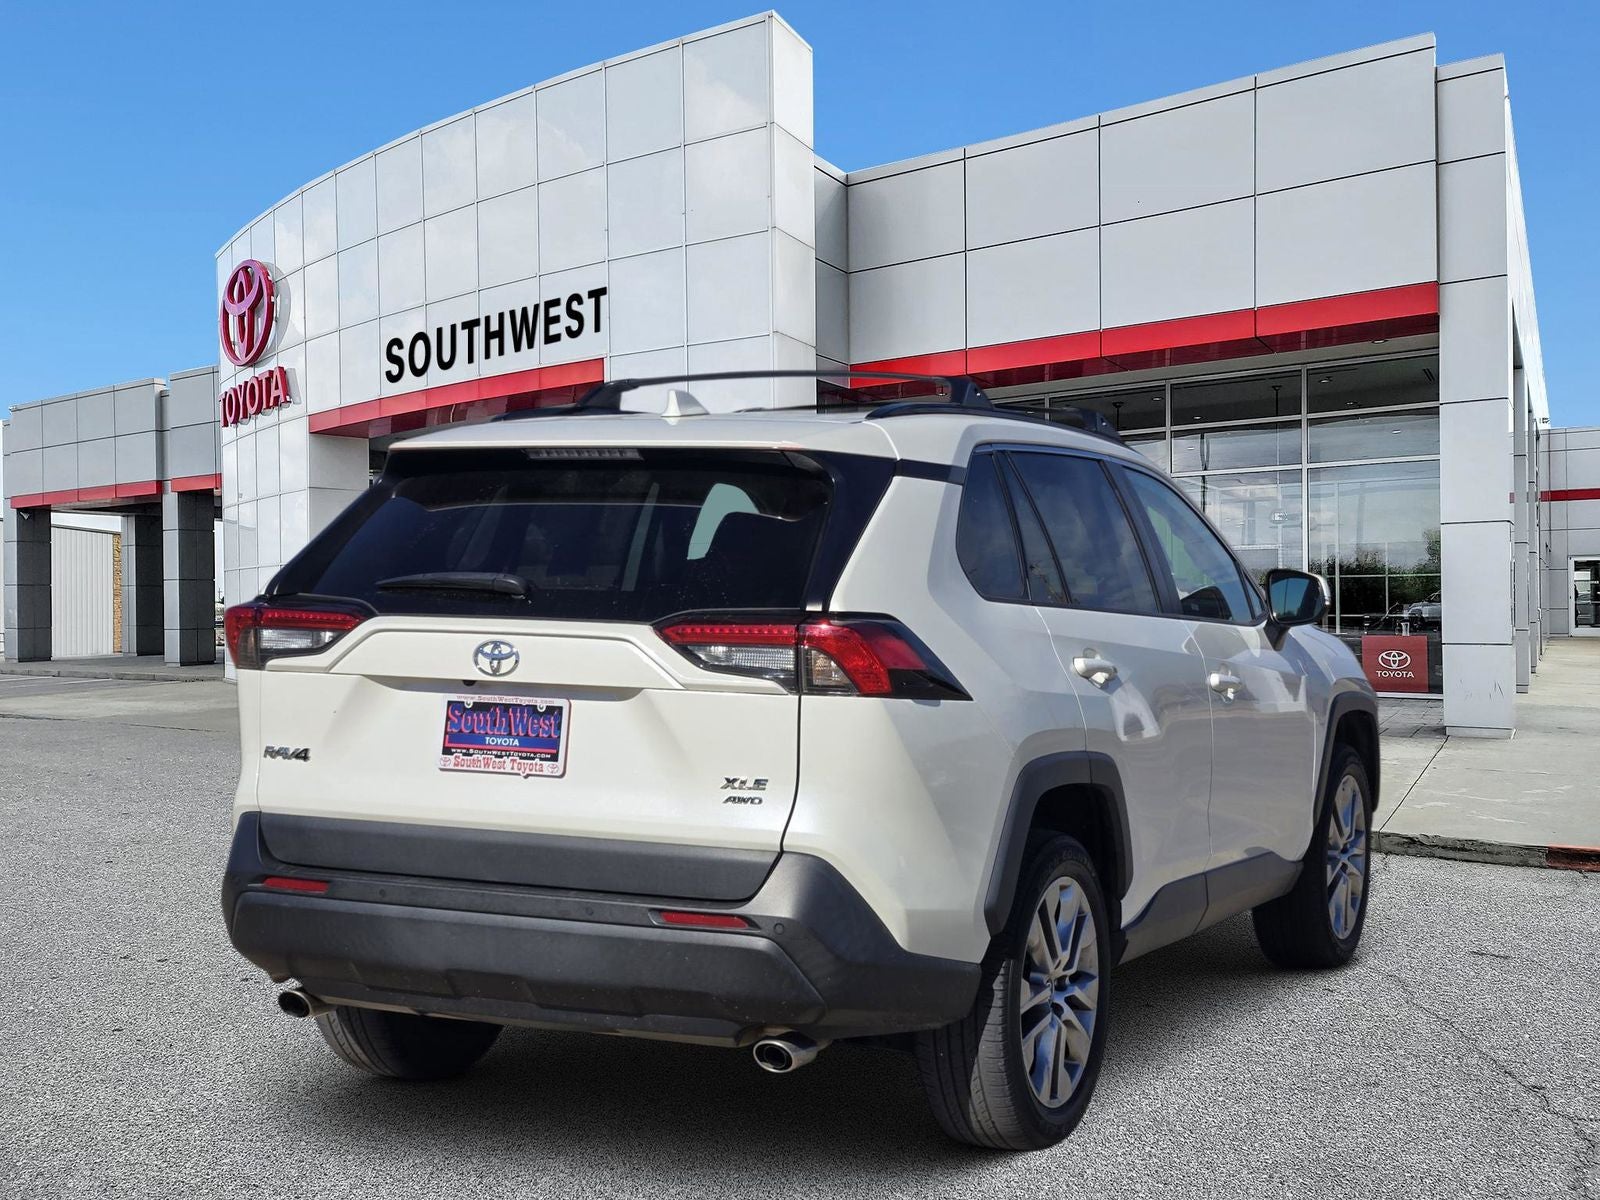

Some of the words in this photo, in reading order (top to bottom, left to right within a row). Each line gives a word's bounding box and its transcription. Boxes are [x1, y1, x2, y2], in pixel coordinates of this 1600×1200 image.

[385, 286, 607, 384] SOUTHWEST
[219, 366, 292, 428] TOYOTA
[1376, 670, 1414, 678] TOYOTA
[447, 703, 561, 738] SouthWest
[485, 736, 519, 746] TOYOTA
[263, 745, 311, 762] RAV4
[453, 755, 506, 770] SouthWest
[510, 759, 544, 774] Toyota
[719, 777, 768, 790] XLE
[722, 796, 763, 805] AWD
